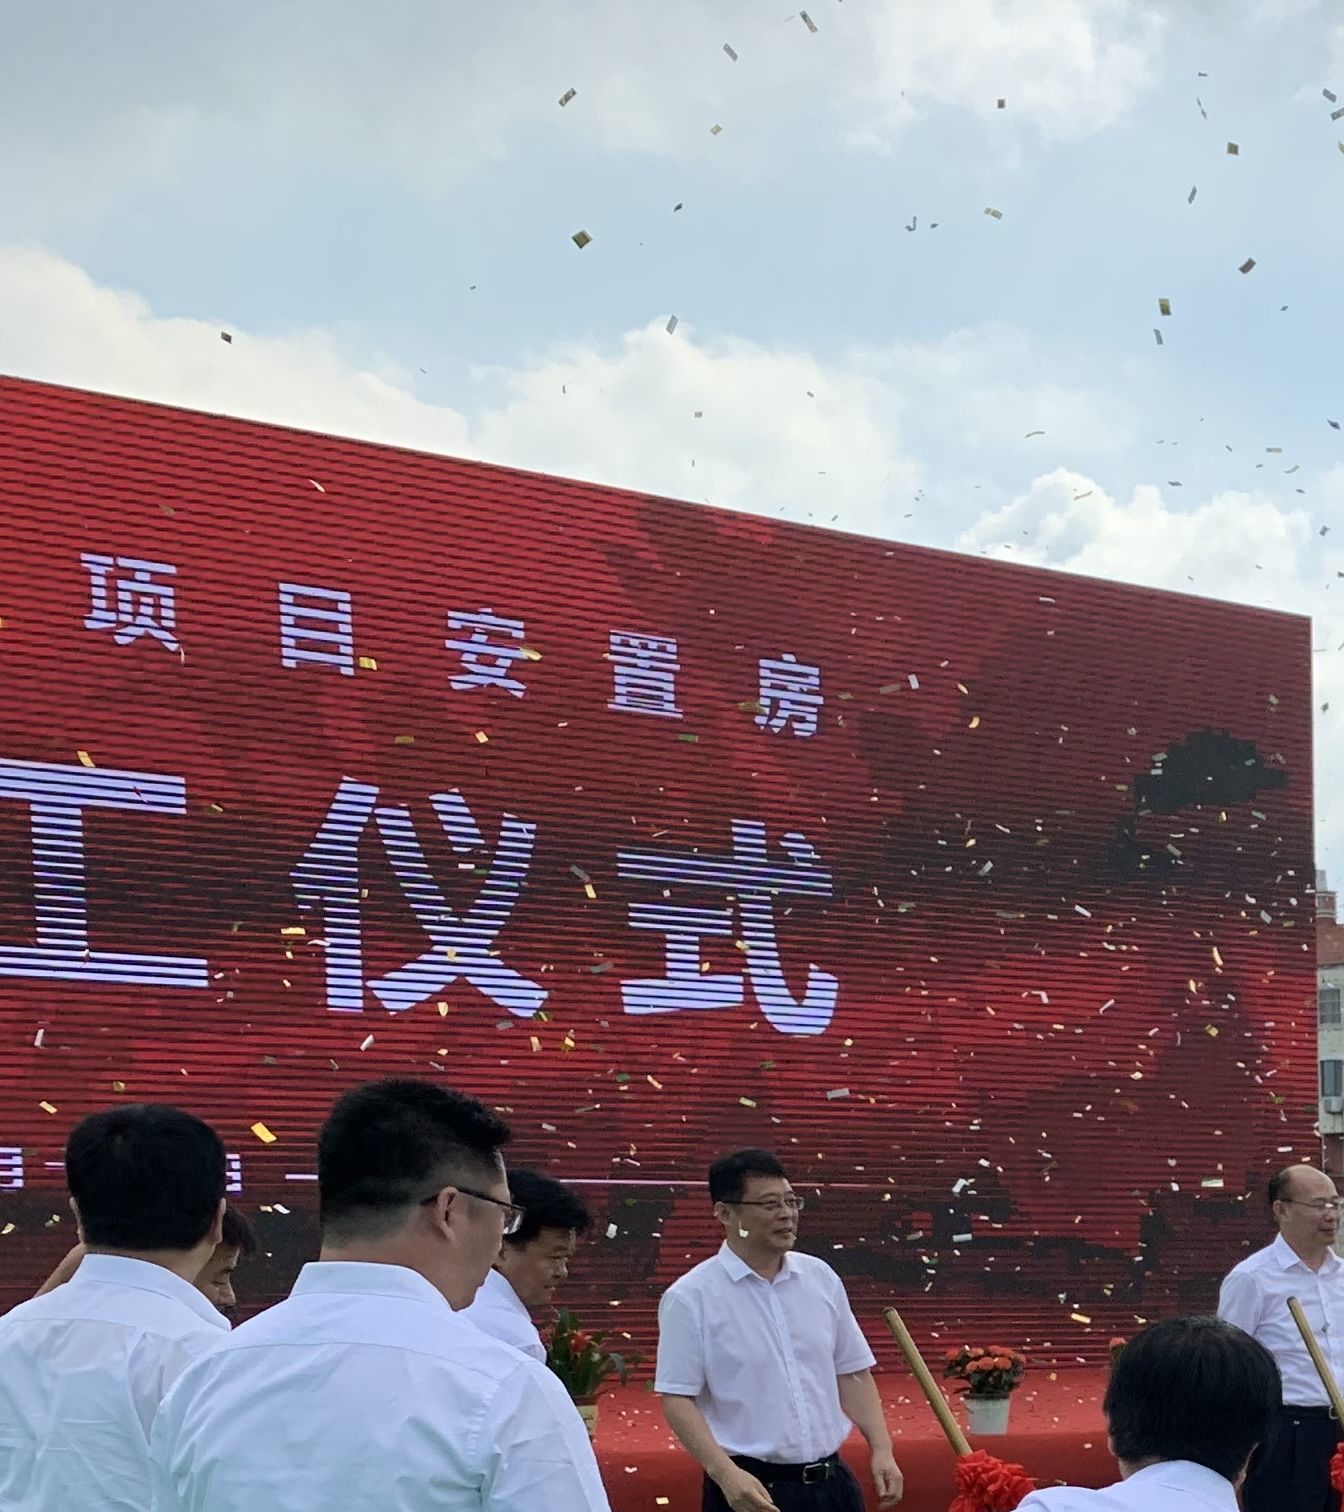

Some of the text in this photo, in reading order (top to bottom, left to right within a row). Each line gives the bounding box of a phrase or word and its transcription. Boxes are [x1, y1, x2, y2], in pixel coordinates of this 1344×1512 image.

[80, 552, 824, 737] 项目安置房
[0, 757, 839, 1036] 工仪式
